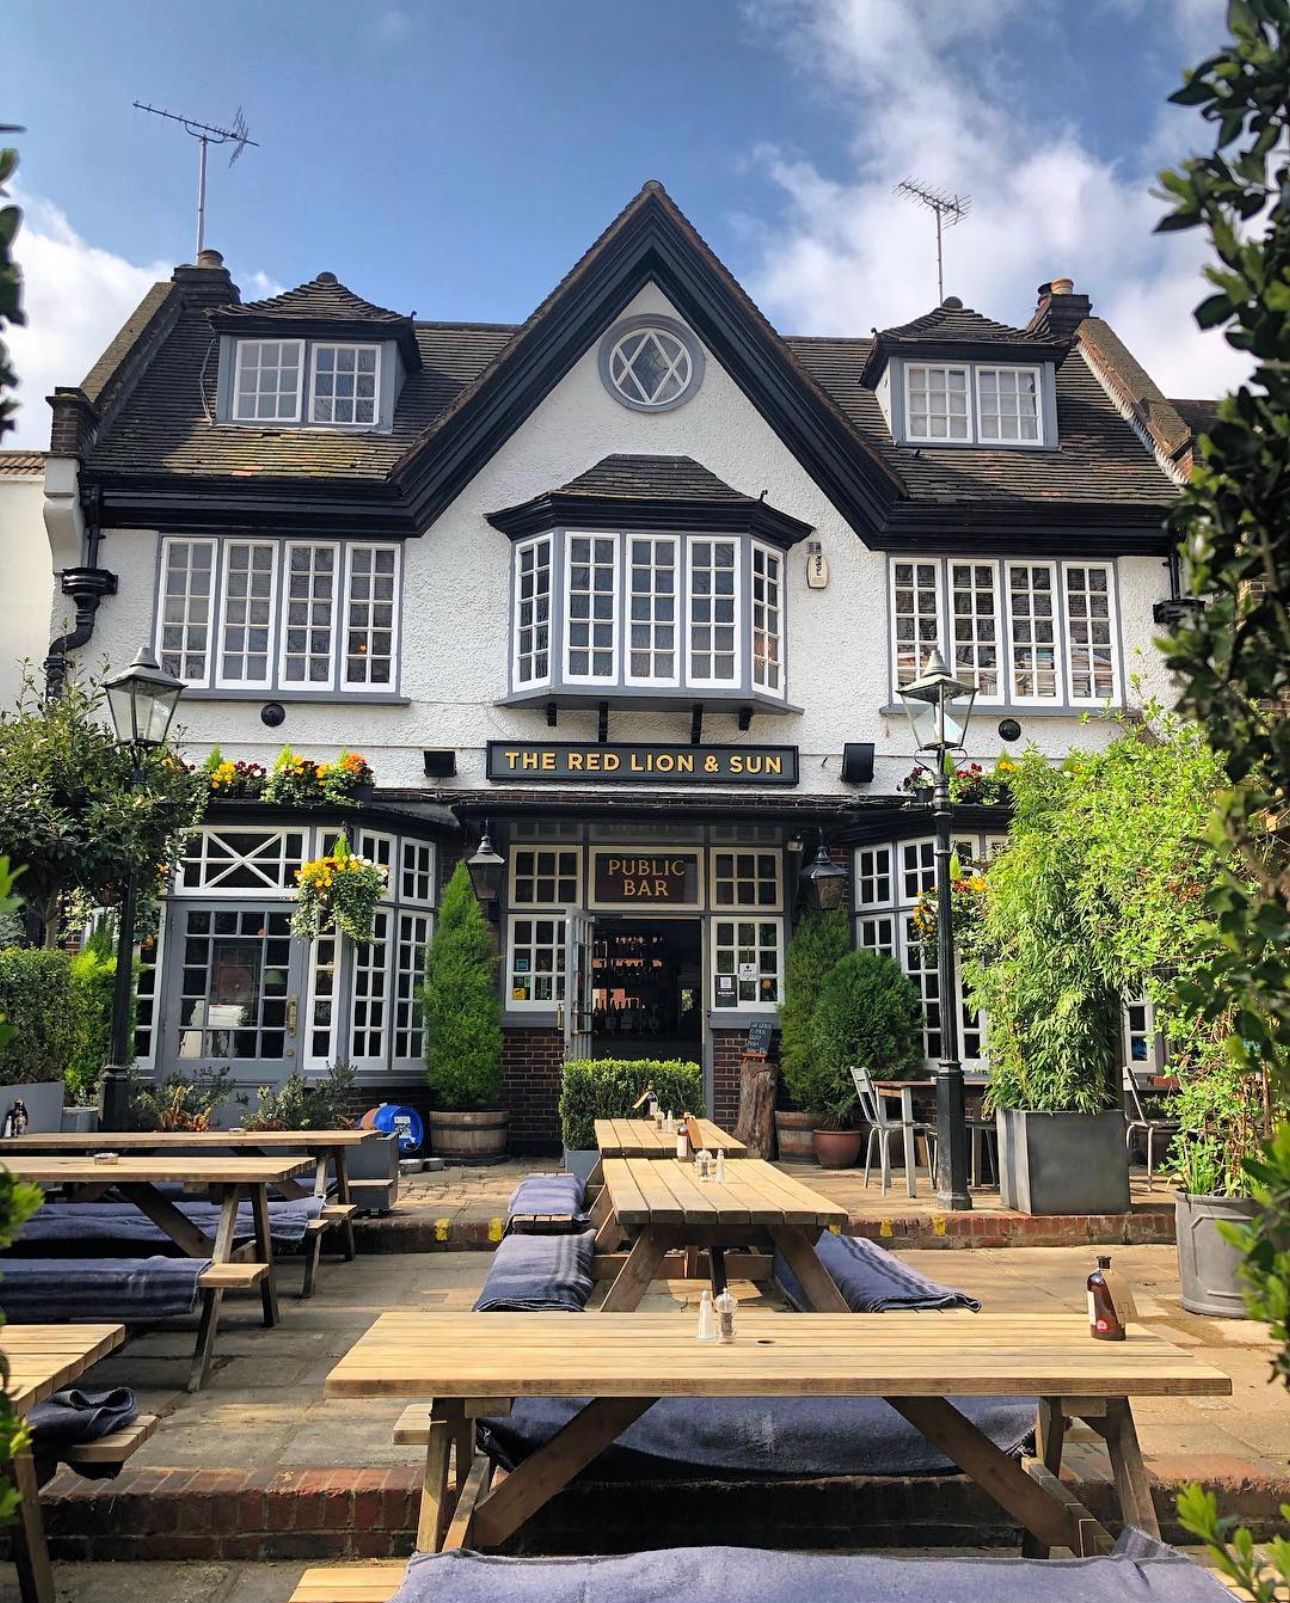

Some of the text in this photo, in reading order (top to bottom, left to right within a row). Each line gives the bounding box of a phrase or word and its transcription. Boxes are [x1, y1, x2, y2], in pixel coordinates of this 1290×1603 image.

[505, 752, 782, 774] THE RED LION & SUN
[608, 859, 685, 876] PUBLIC
[623, 879, 669, 896] BAR
